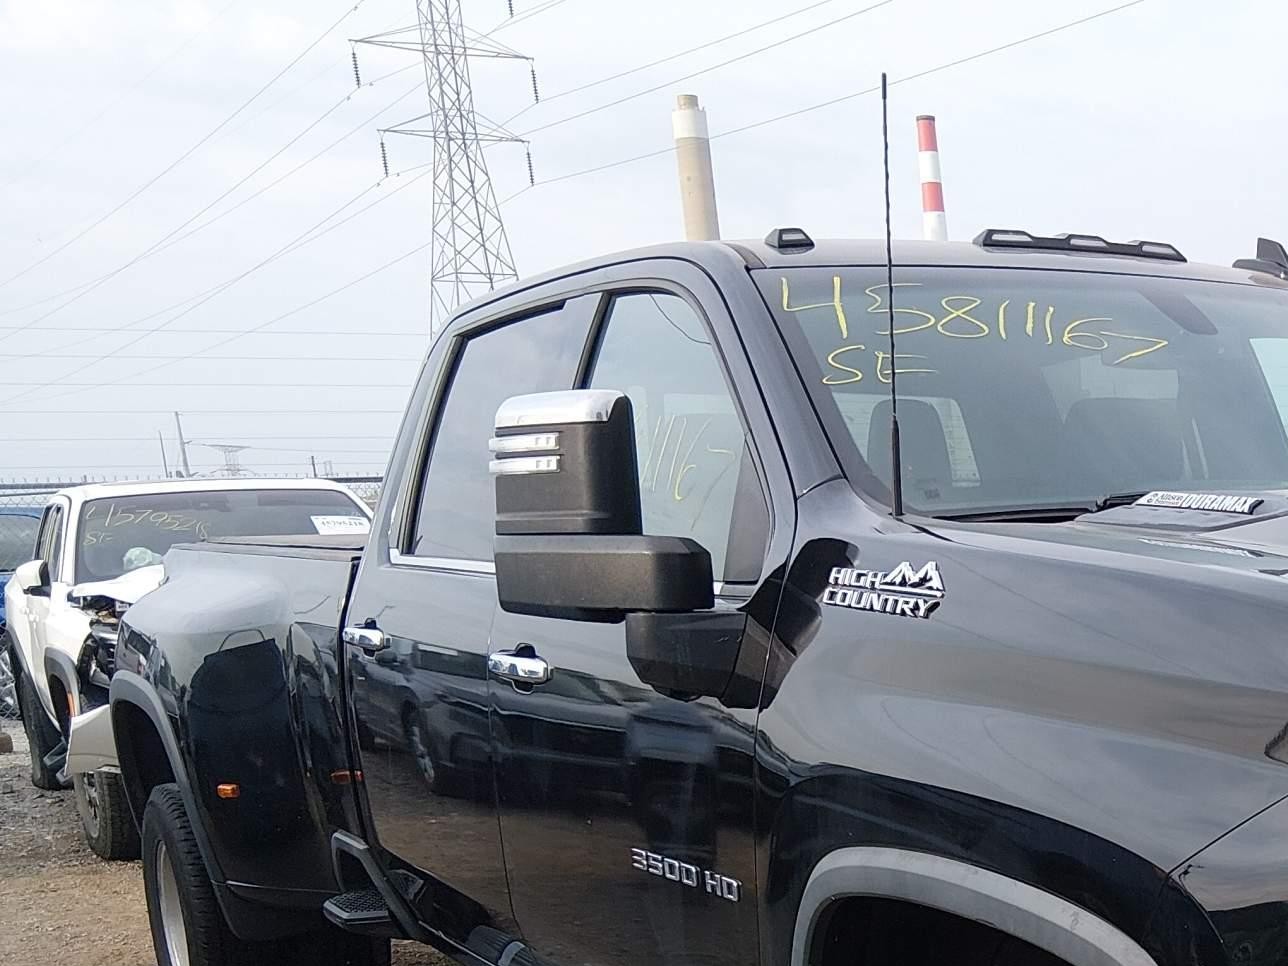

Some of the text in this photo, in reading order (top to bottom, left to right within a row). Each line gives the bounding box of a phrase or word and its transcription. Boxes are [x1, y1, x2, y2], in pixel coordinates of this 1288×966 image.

[781, 276, 1169, 365] 45811167
[822, 344, 938, 385] SE
[1181, 493, 1258, 514] DURAMAX
[828, 567, 885, 590] HIGH
[822, 587, 941, 619] COUNTRY
[630, 847, 742, 902] 3500 HD
